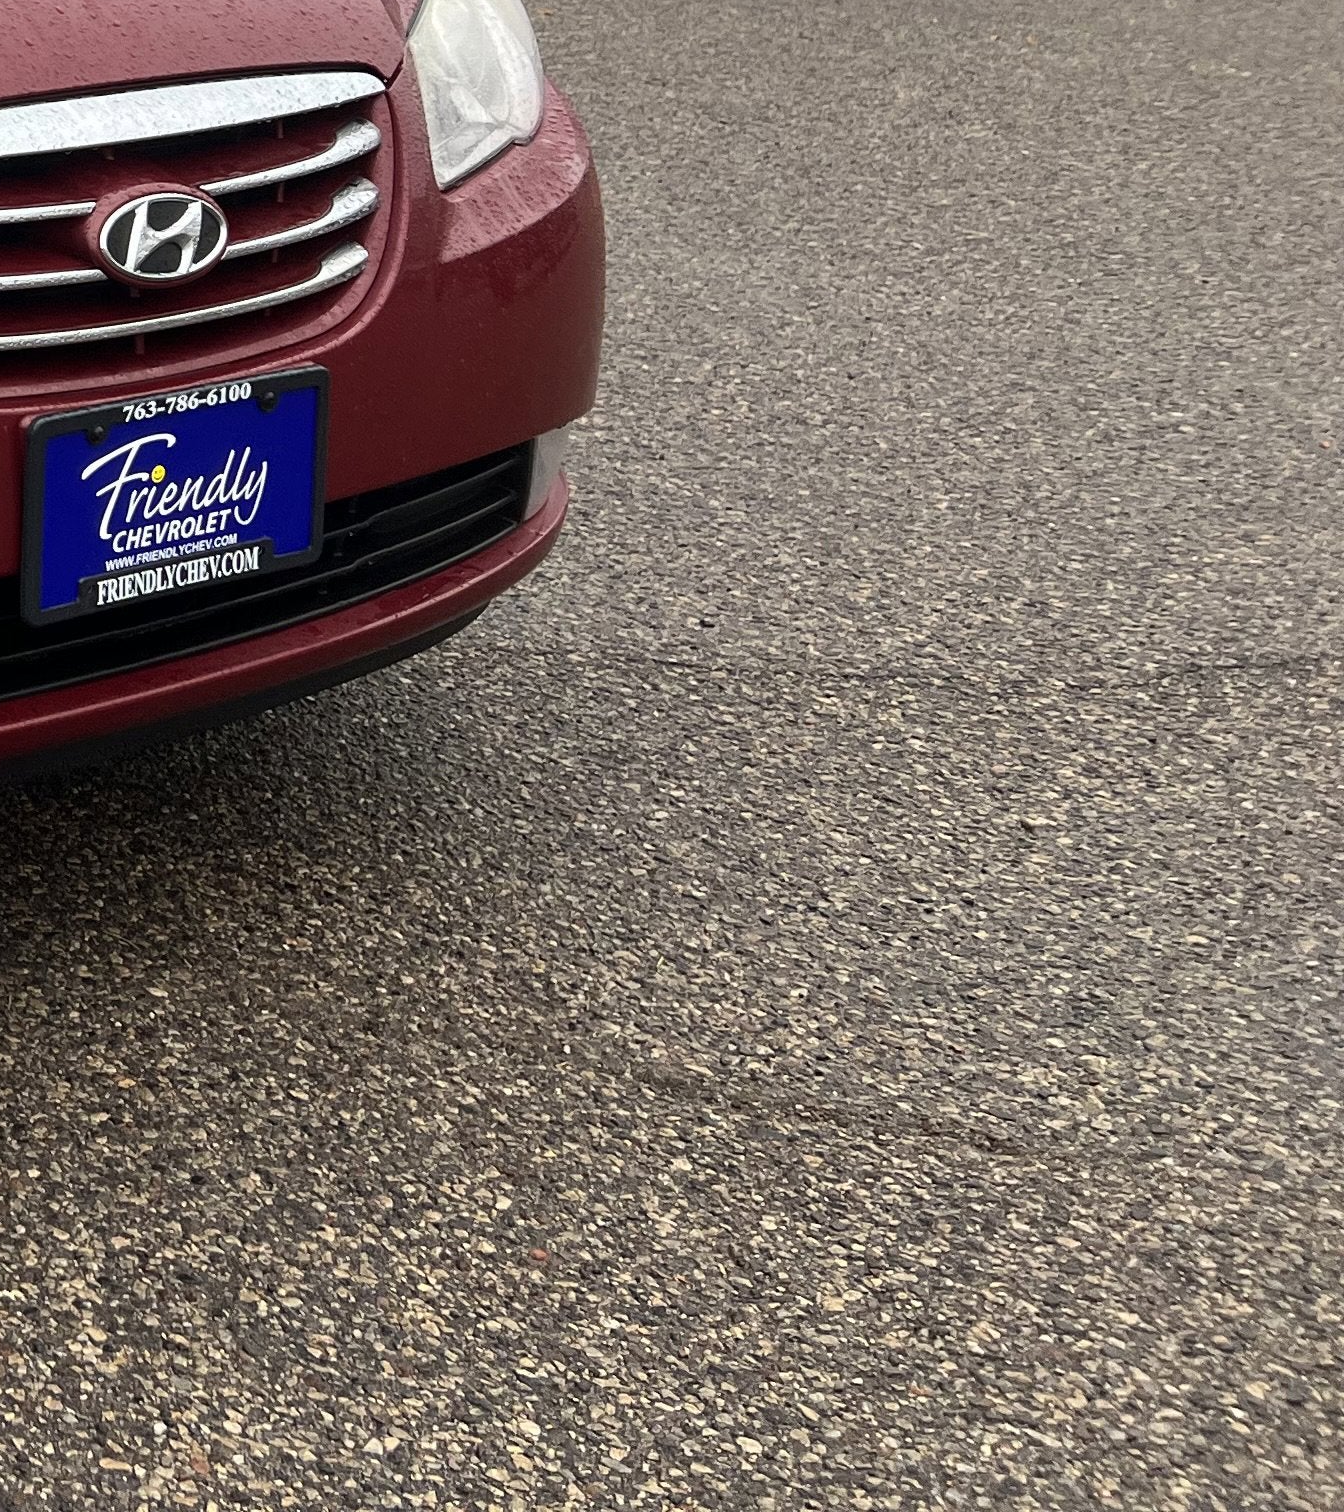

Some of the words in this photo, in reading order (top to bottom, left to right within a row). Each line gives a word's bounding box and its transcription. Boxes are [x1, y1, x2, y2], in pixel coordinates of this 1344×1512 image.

[122, 382, 252, 423] 763-786-6100
[80, 432, 268, 540] Friendly
[105, 533, 237, 572] WWW.FRIENDLYCHEV.COM
[112, 508, 232, 553] CHEVROLET
[96, 546, 260, 606] FRIENDLYCHEV.COM
